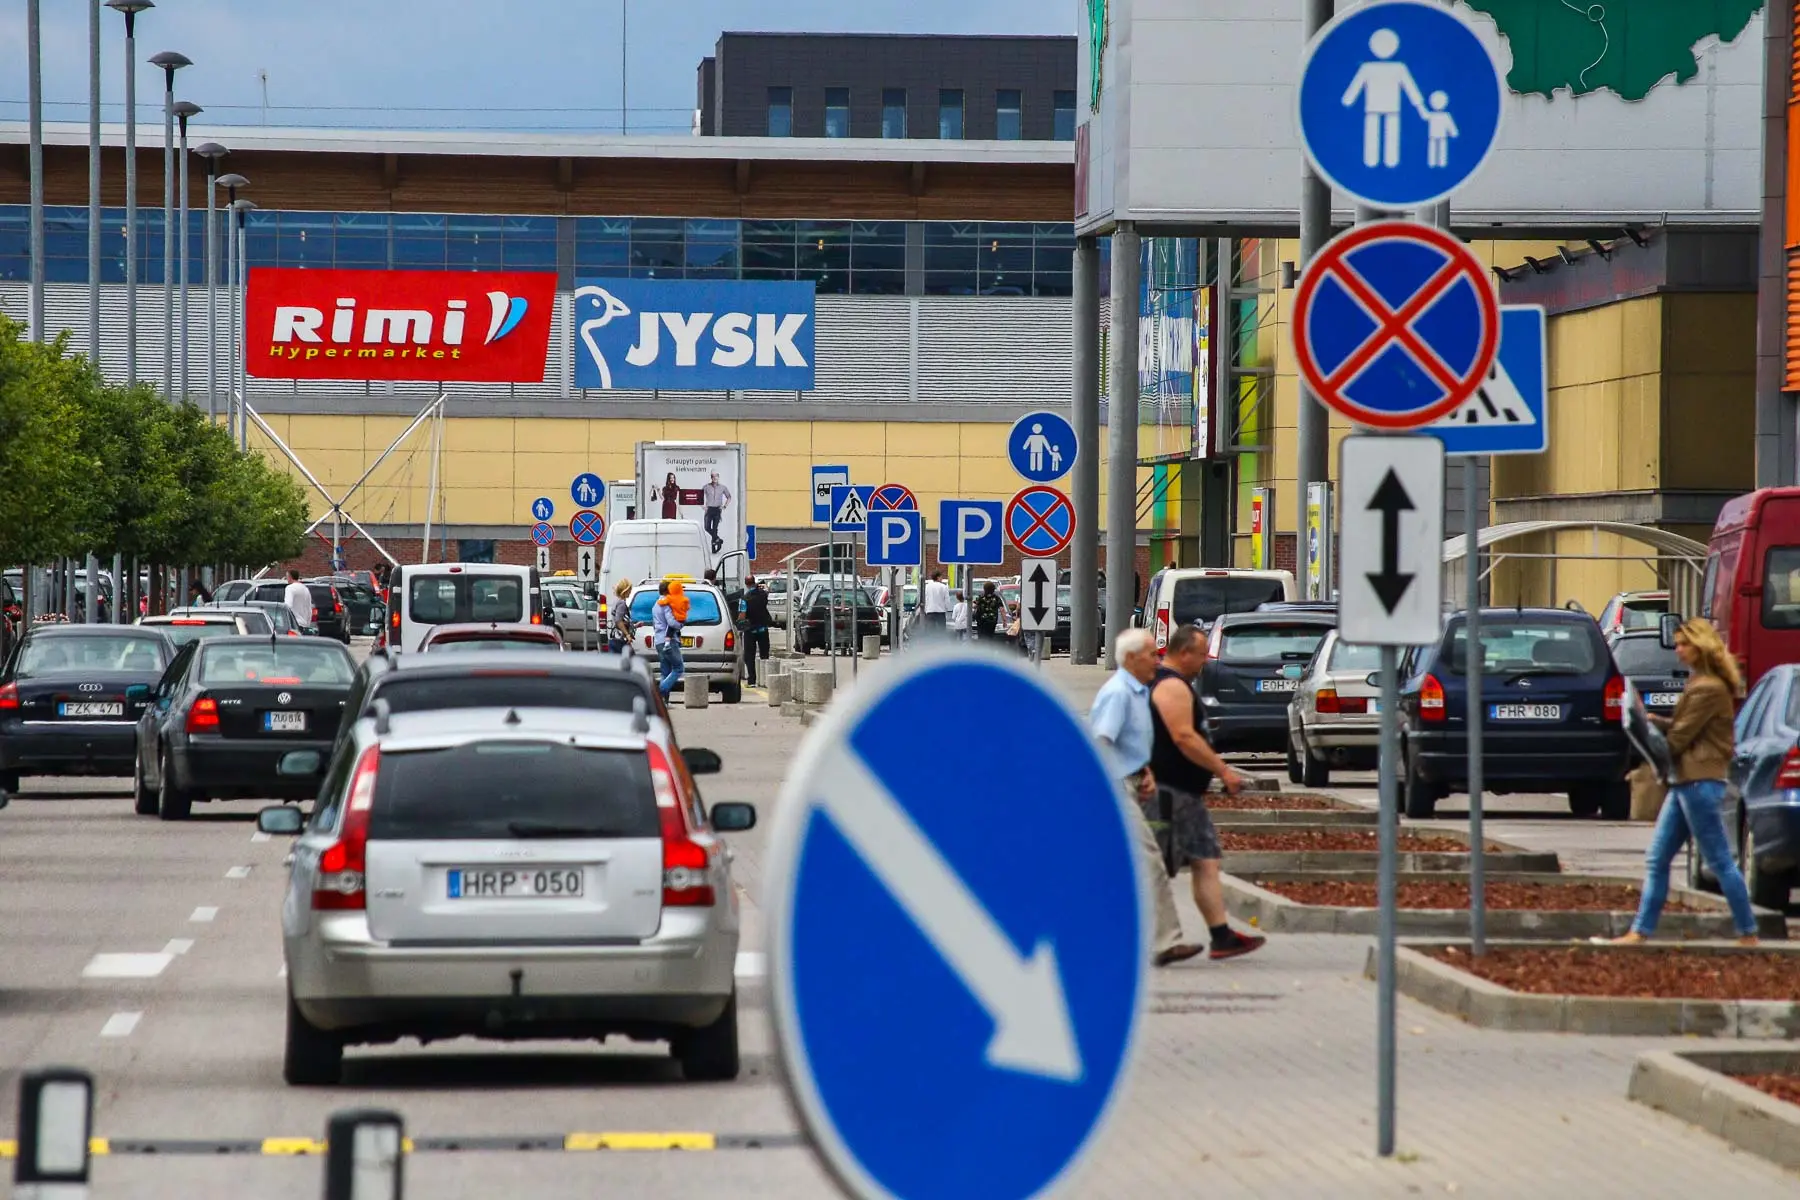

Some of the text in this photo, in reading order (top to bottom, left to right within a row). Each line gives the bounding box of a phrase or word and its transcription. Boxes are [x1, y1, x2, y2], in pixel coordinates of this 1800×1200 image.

[272, 297, 467, 345] Rimi
[625, 312, 808, 367] JYSK
[269, 346, 461, 360] Hypermarket
[882, 517, 911, 559] P
[957, 507, 992, 557] P
[1262, 681, 1285, 690] EOH
[1651, 693, 1675, 704] GCC
[66, 703, 91, 715] FZK
[98, 703, 121, 714] 471
[1499, 705, 1558, 718] FHR 080
[463, 872, 579, 894] HRP 050
